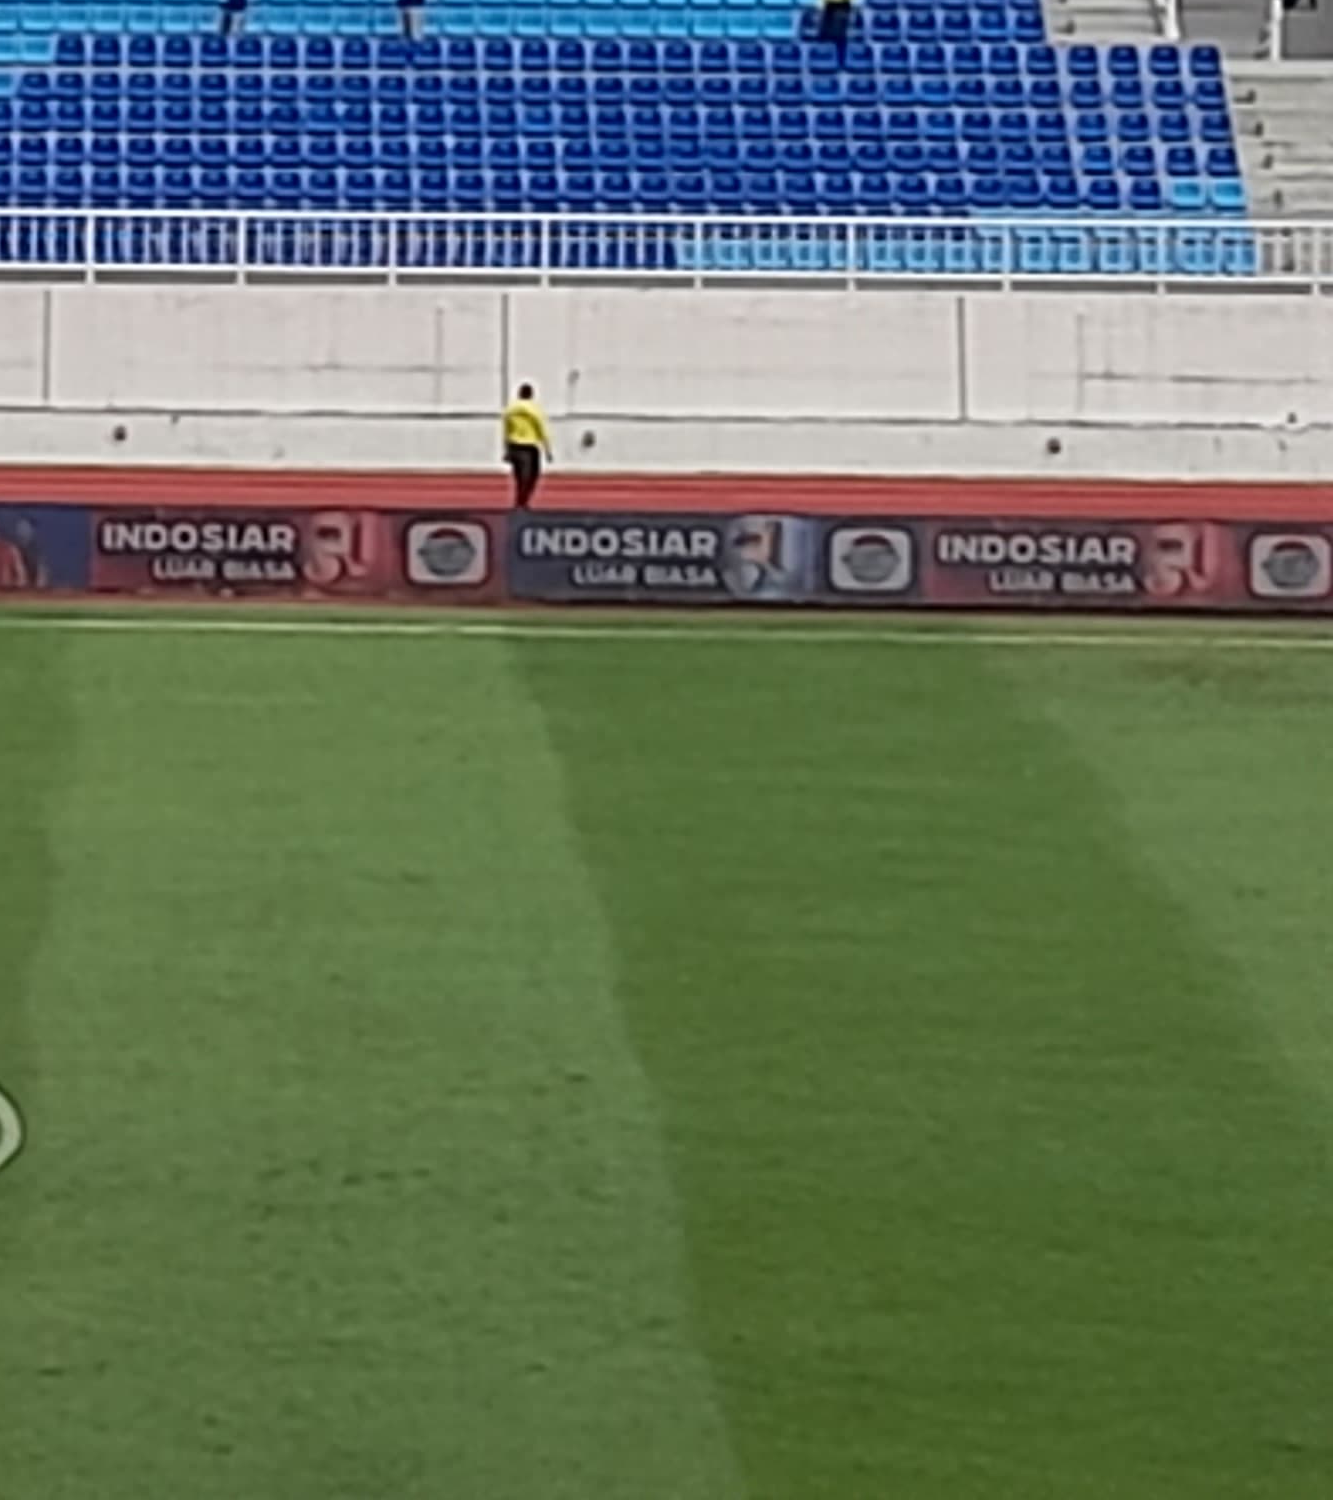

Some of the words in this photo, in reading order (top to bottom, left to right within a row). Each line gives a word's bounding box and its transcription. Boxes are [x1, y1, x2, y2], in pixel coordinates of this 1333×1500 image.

[103, 523, 296, 552] INDOSIAR
[522, 528, 718, 557] INDOSIAR
[938, 534, 1136, 564] INDOSIAR
